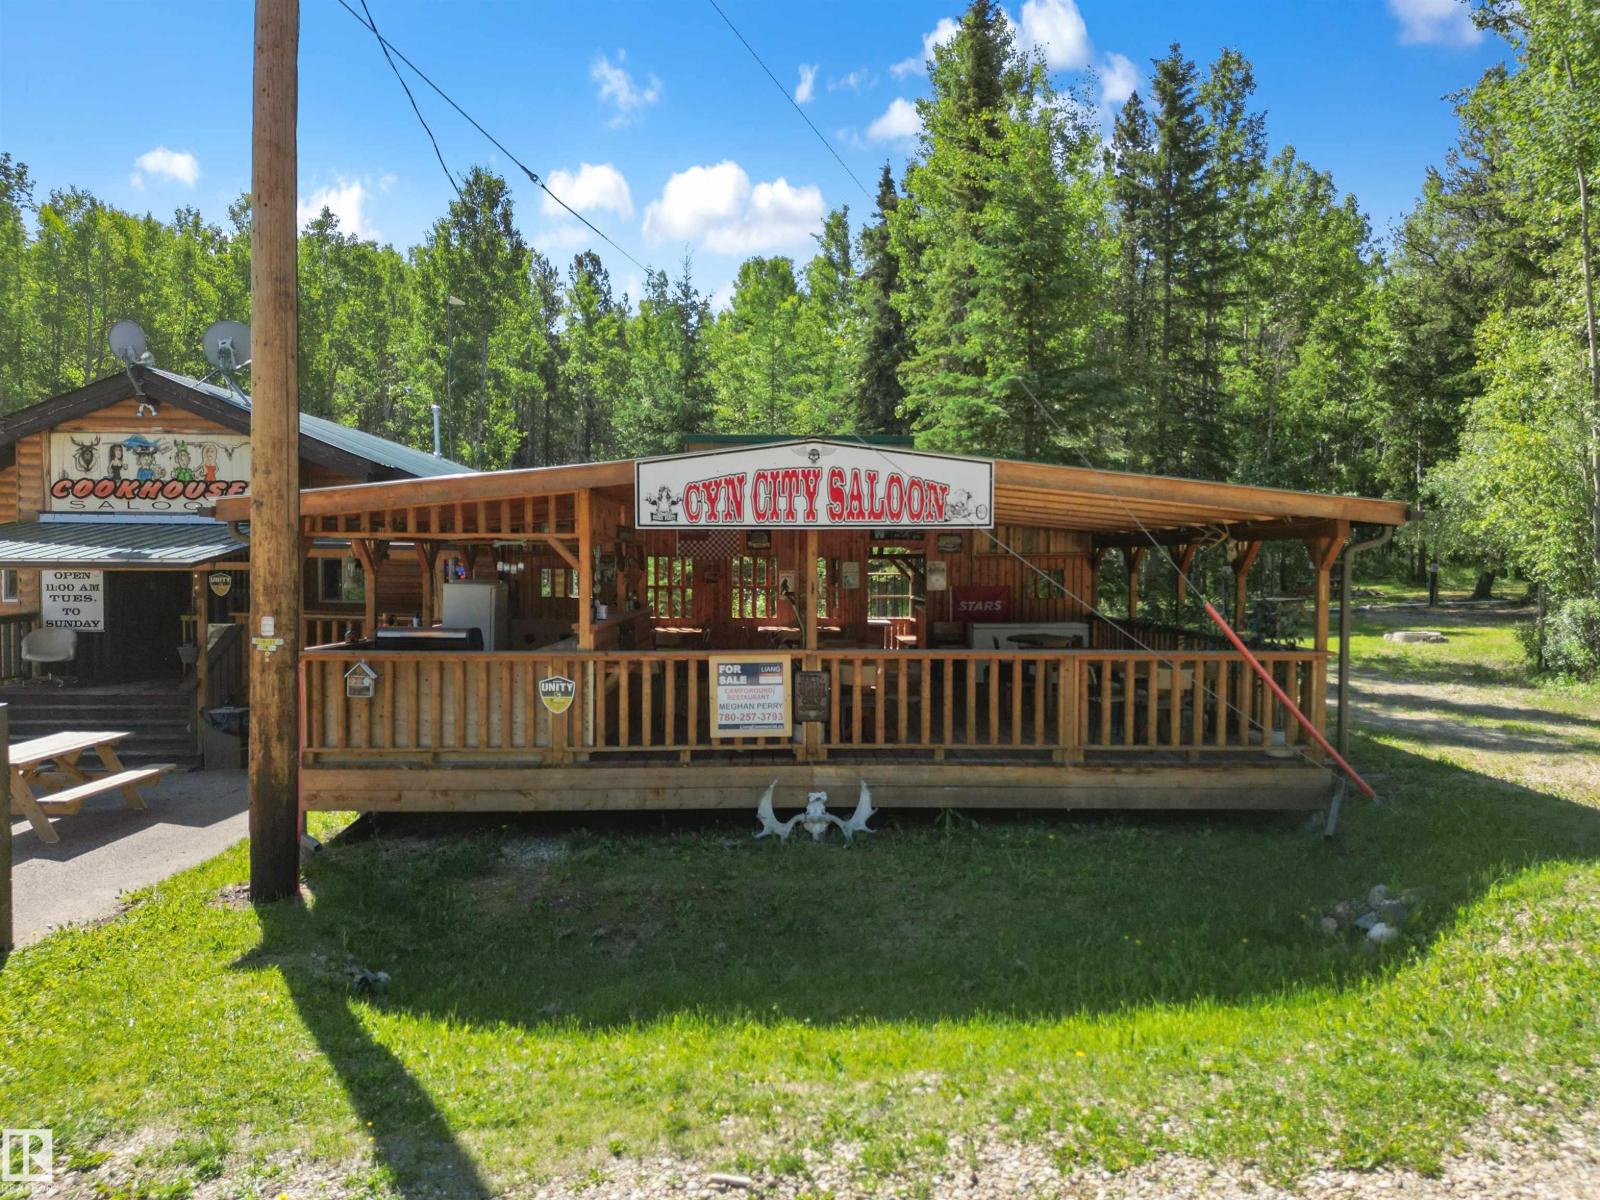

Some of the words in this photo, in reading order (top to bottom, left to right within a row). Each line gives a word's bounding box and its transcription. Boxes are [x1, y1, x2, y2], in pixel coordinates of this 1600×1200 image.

[50, 478, 248, 500] COOKHOUSE
[682, 472, 747, 523] CYN
[750, 466, 822, 523] CITY
[826, 466, 950, 523] SALOON
[69, 500, 204, 511] SALOO
[54, 571, 91, 580] OPEN
[45, 583, 75, 592] 11:00
[79, 583, 100, 592] AM
[49, 594, 97, 602] TUES.
[957, 600, 1003, 612] STARS
[62, 607, 81, 616] TO
[45, 619, 100, 628] SUNDAY
[718, 664, 742, 674] FOR
[760, 665, 781, 673] LIANG
[718, 675, 748, 685] SALE
[541, 682, 573, 692] UNITY
[719, 703, 755, 711] MEGHAN
[756, 702, 783, 710] PERRY
[719, 712, 784, 722] 780-257-3793
